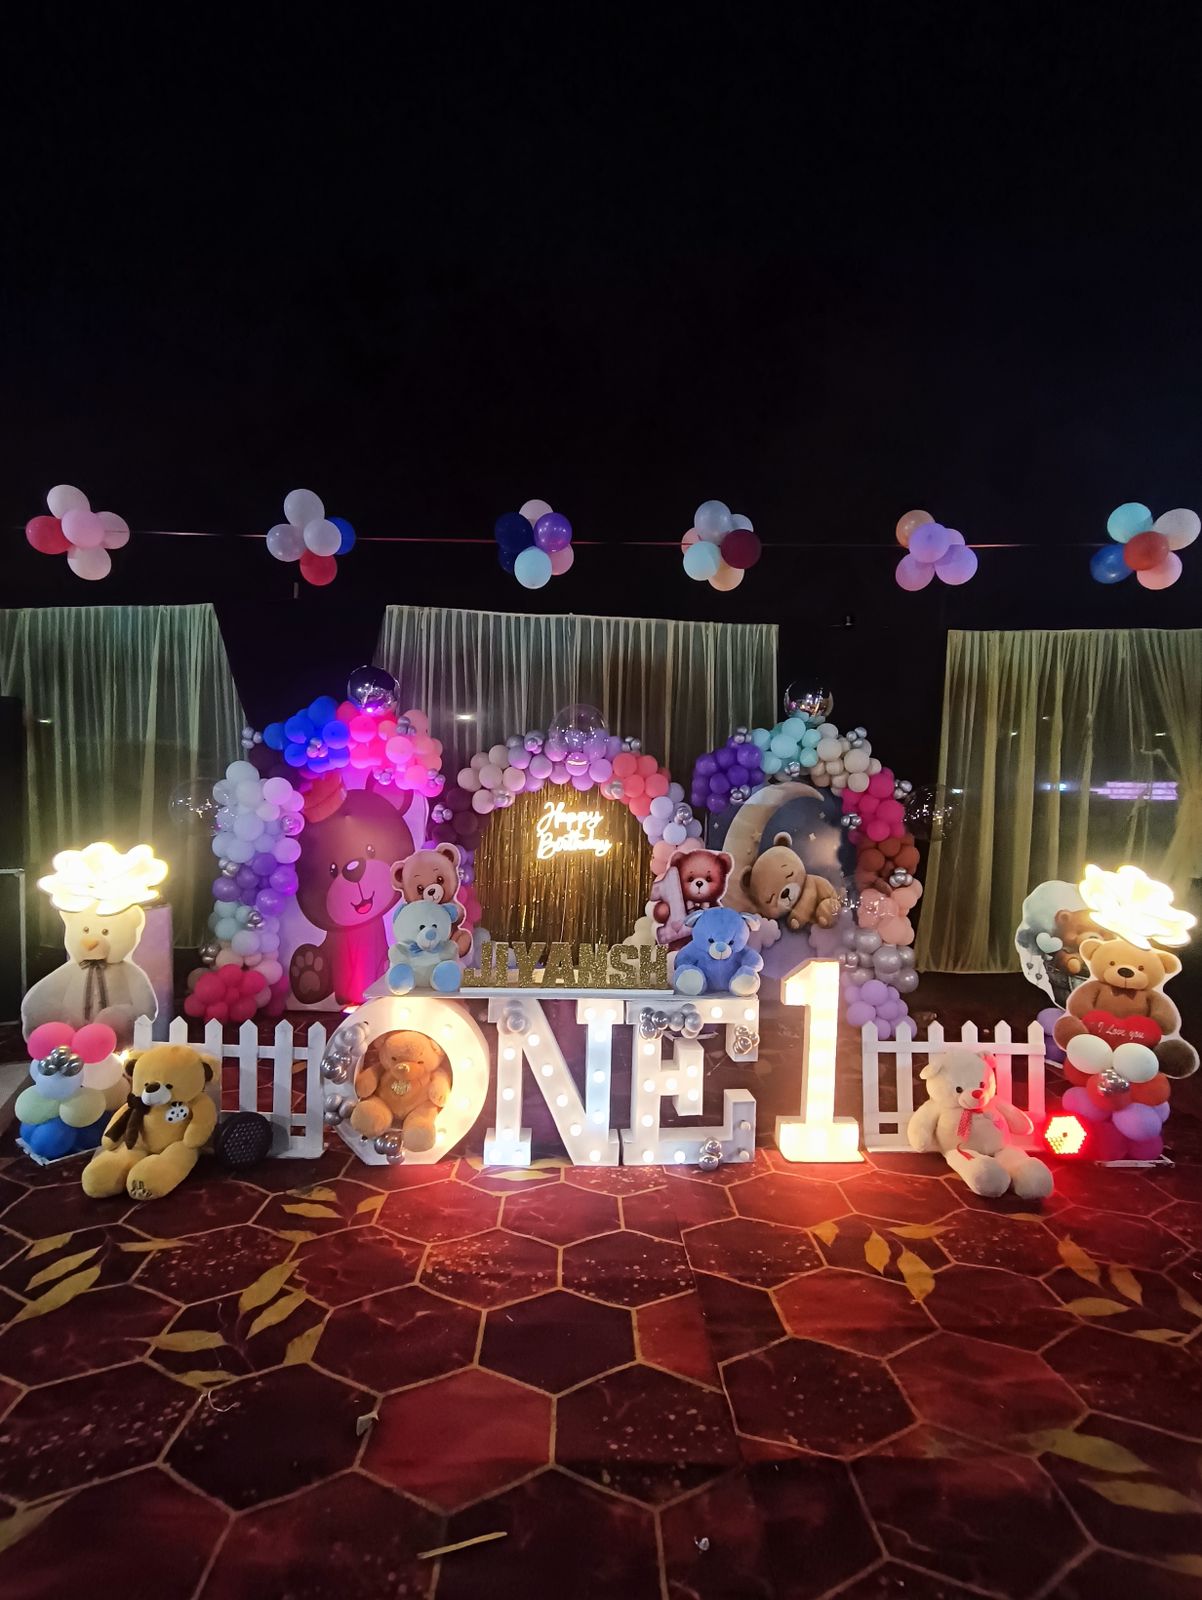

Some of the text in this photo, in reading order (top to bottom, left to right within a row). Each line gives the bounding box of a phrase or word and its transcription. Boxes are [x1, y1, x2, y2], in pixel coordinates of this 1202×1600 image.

[536, 801, 604, 833] Happy
[536, 829, 613, 860] Birthday
[463, 941, 669, 988] JIYANSH
[1128, 1030, 1145, 1041] you
[322, 957, 865, 1167] ONE 1
